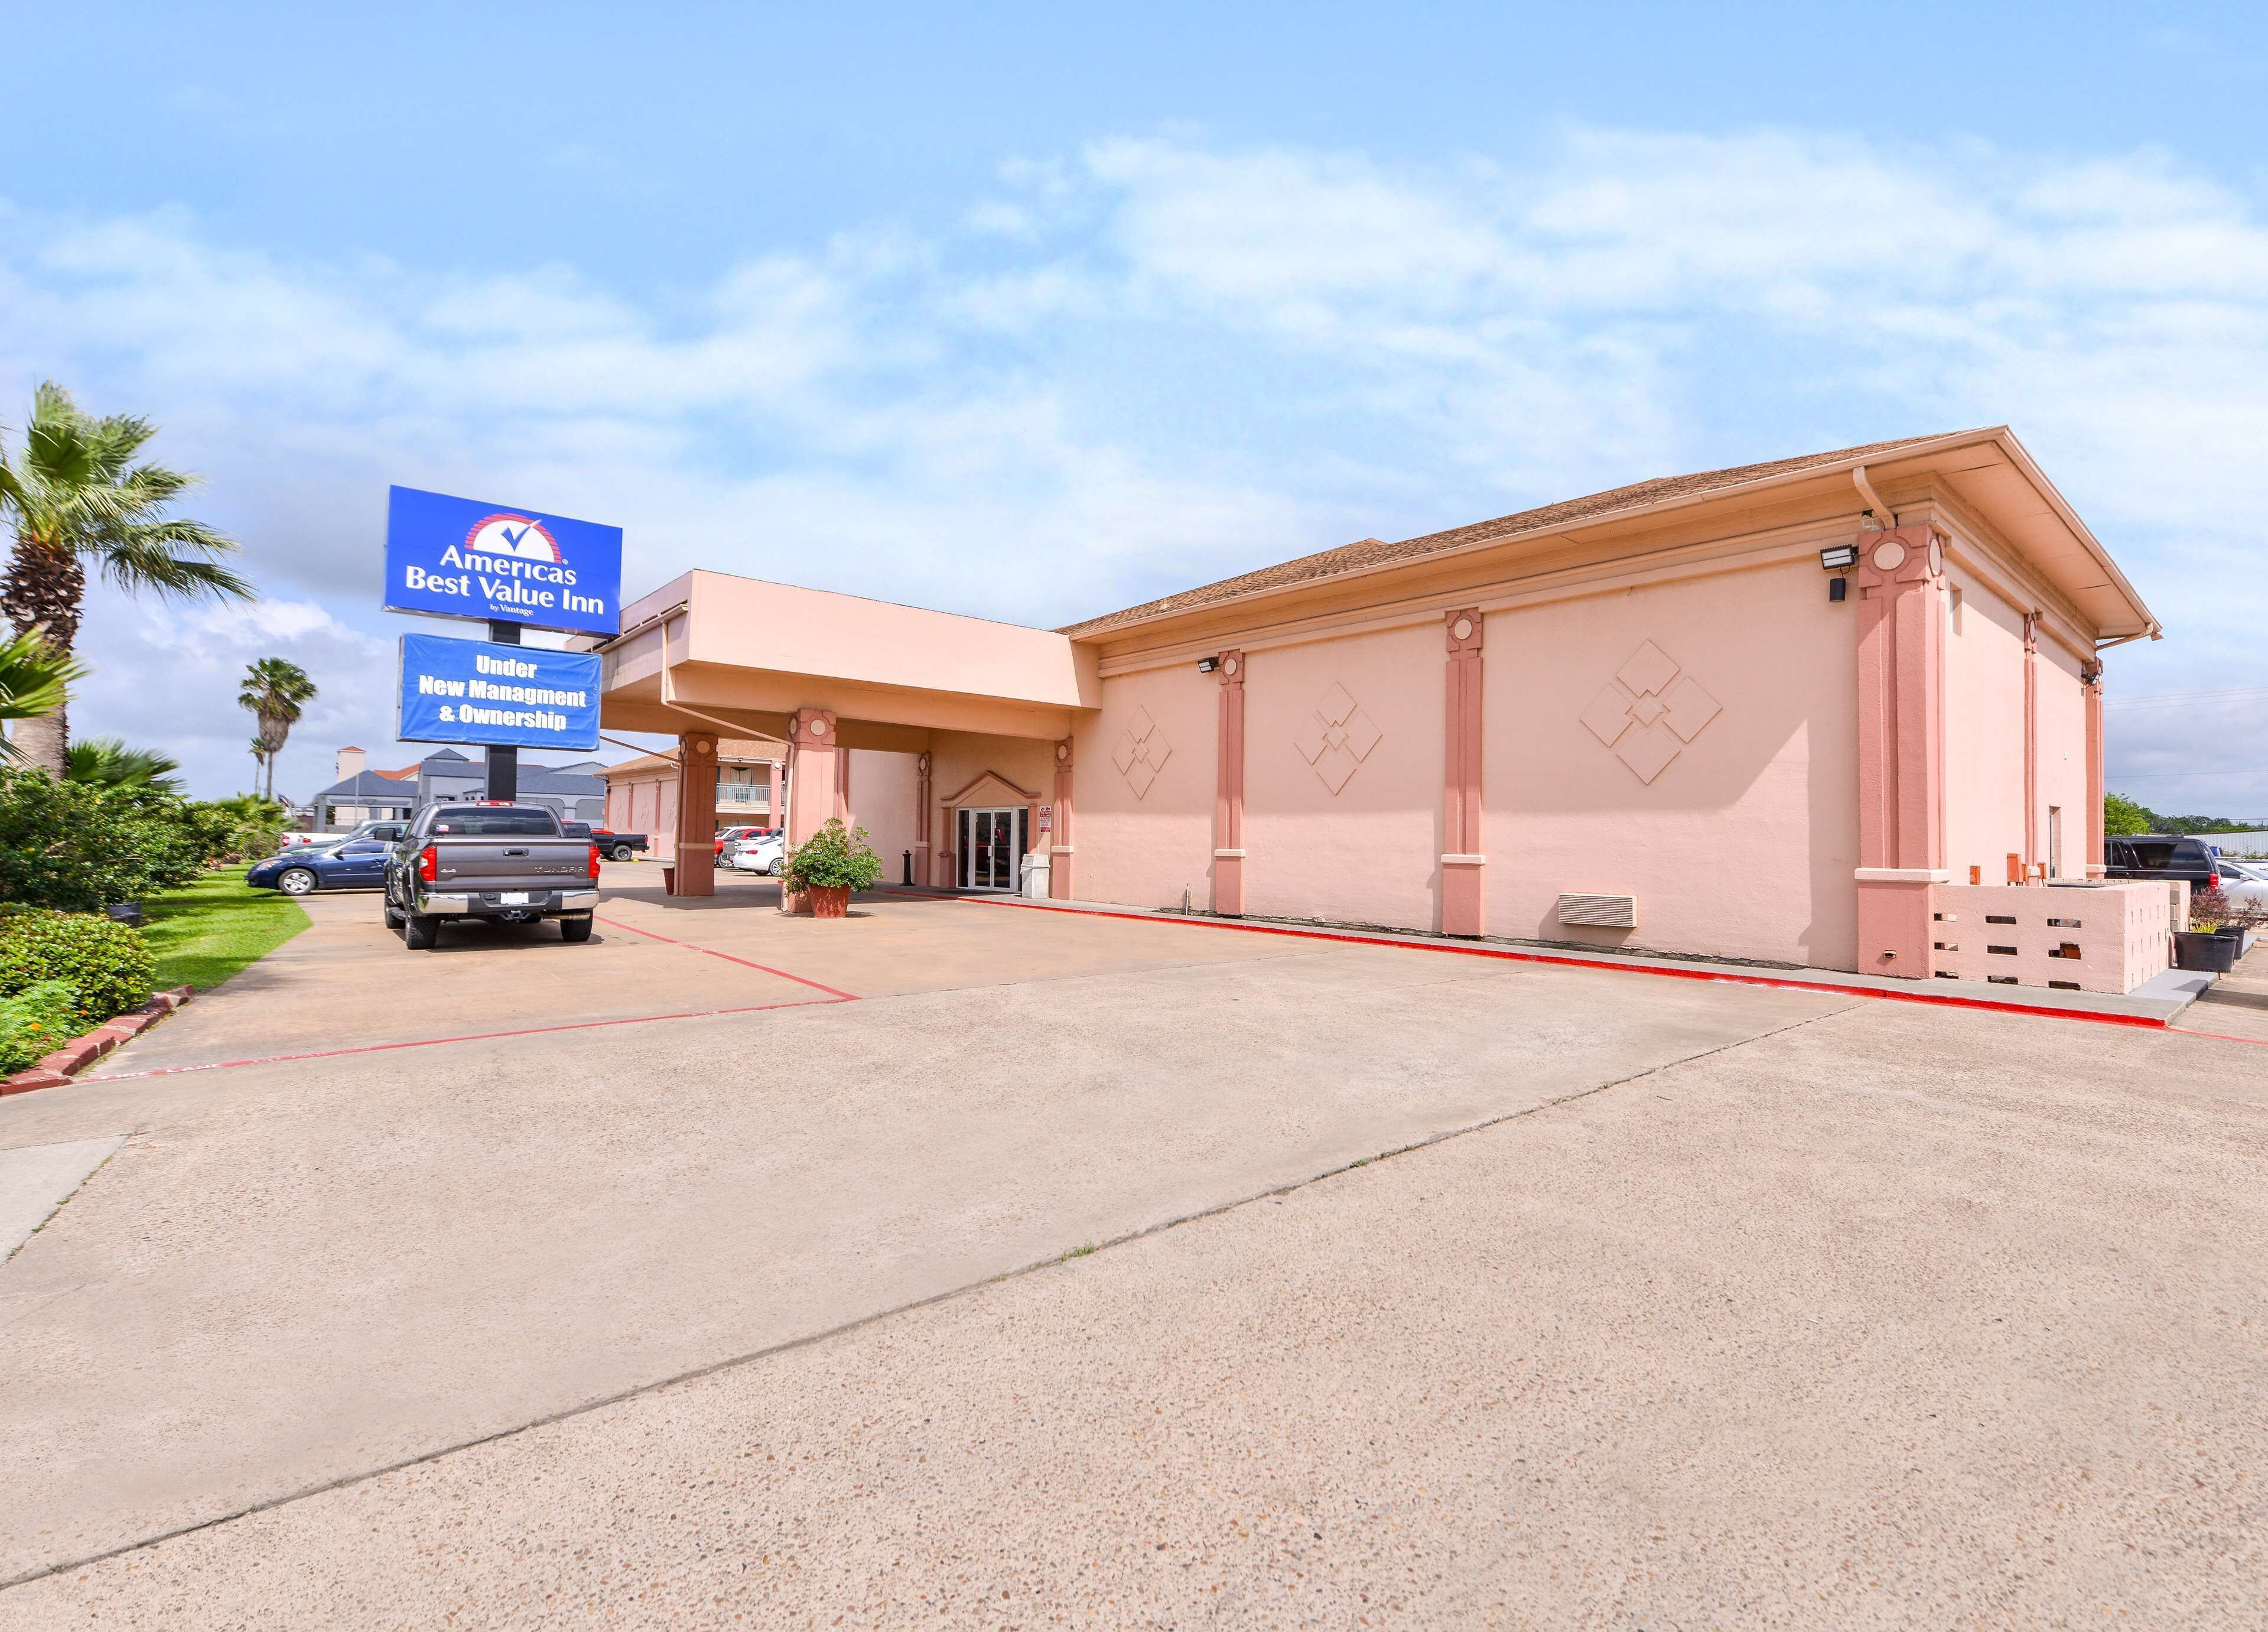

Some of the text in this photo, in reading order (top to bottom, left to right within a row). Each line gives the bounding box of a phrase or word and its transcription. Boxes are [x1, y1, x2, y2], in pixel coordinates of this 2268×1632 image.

[440, 545, 577, 585] Americas
[406, 564, 604, 615] Best Value Inn
[489, 603, 535, 617] by Vantage
[476, 654, 538, 679] Under
[419, 674, 587, 707] New Managment
[439, 704, 567, 732] & Ownership
